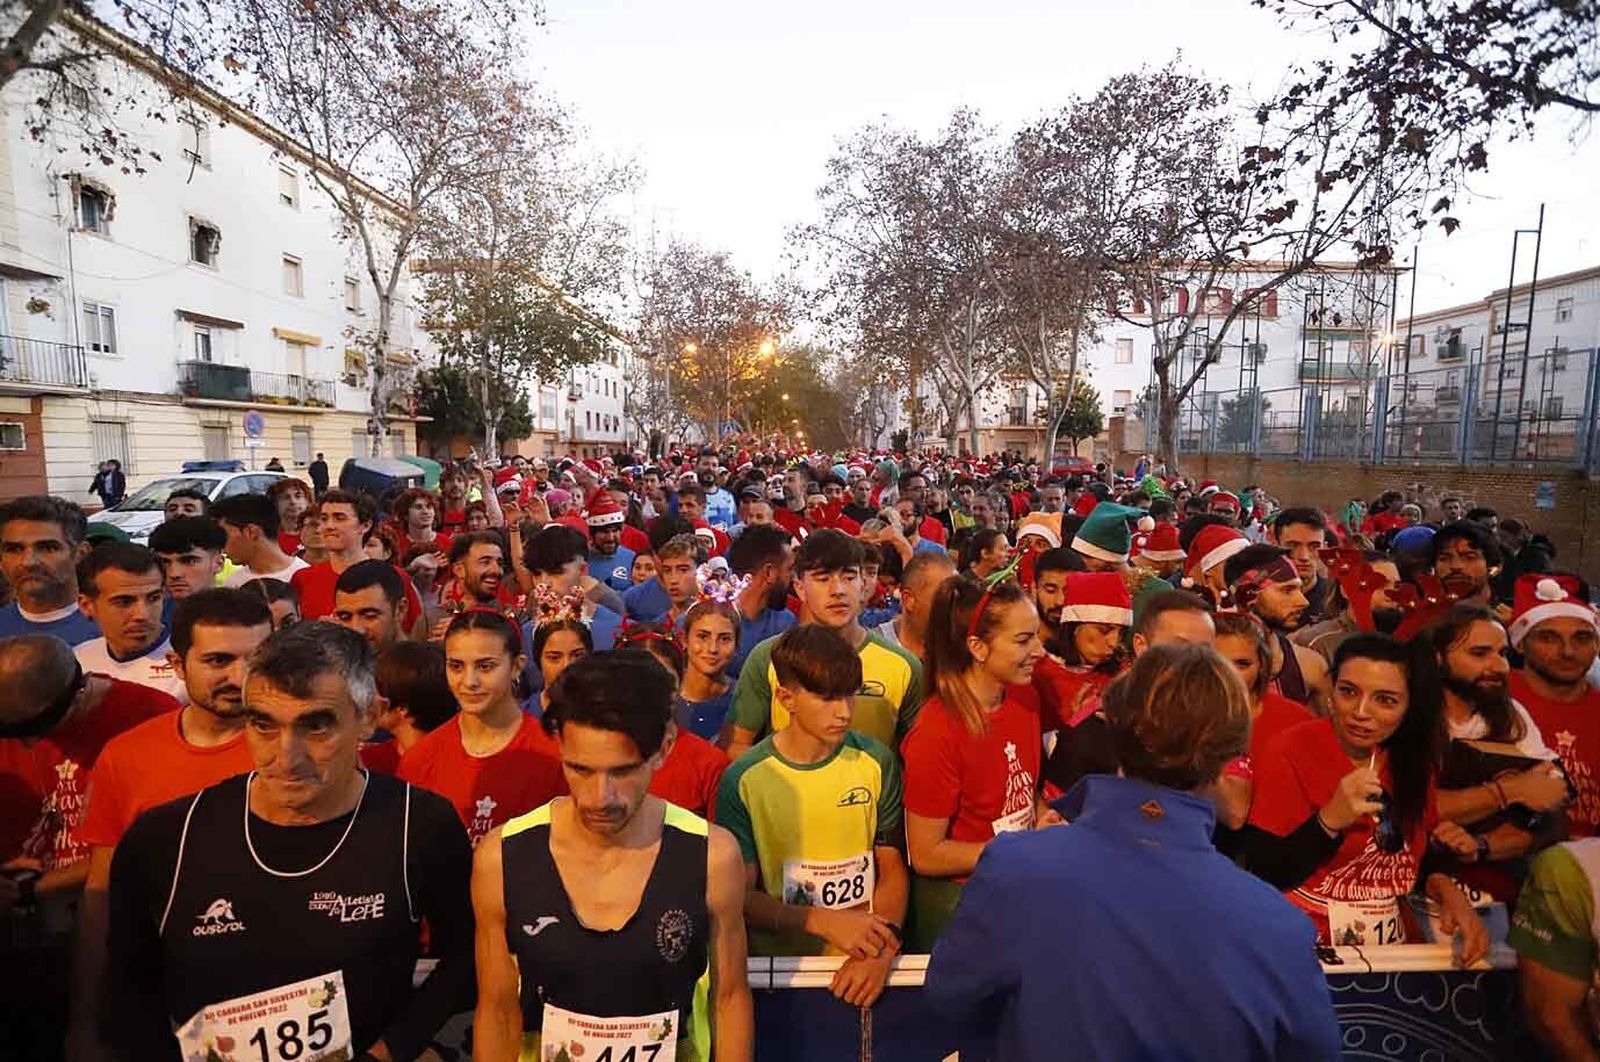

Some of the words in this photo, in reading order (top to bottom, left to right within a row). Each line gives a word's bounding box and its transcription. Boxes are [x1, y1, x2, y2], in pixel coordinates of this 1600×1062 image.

[1361, 863, 1416, 881] Huelva
[821, 875, 865, 906] 628
[249, 1009, 333, 1062] 185
